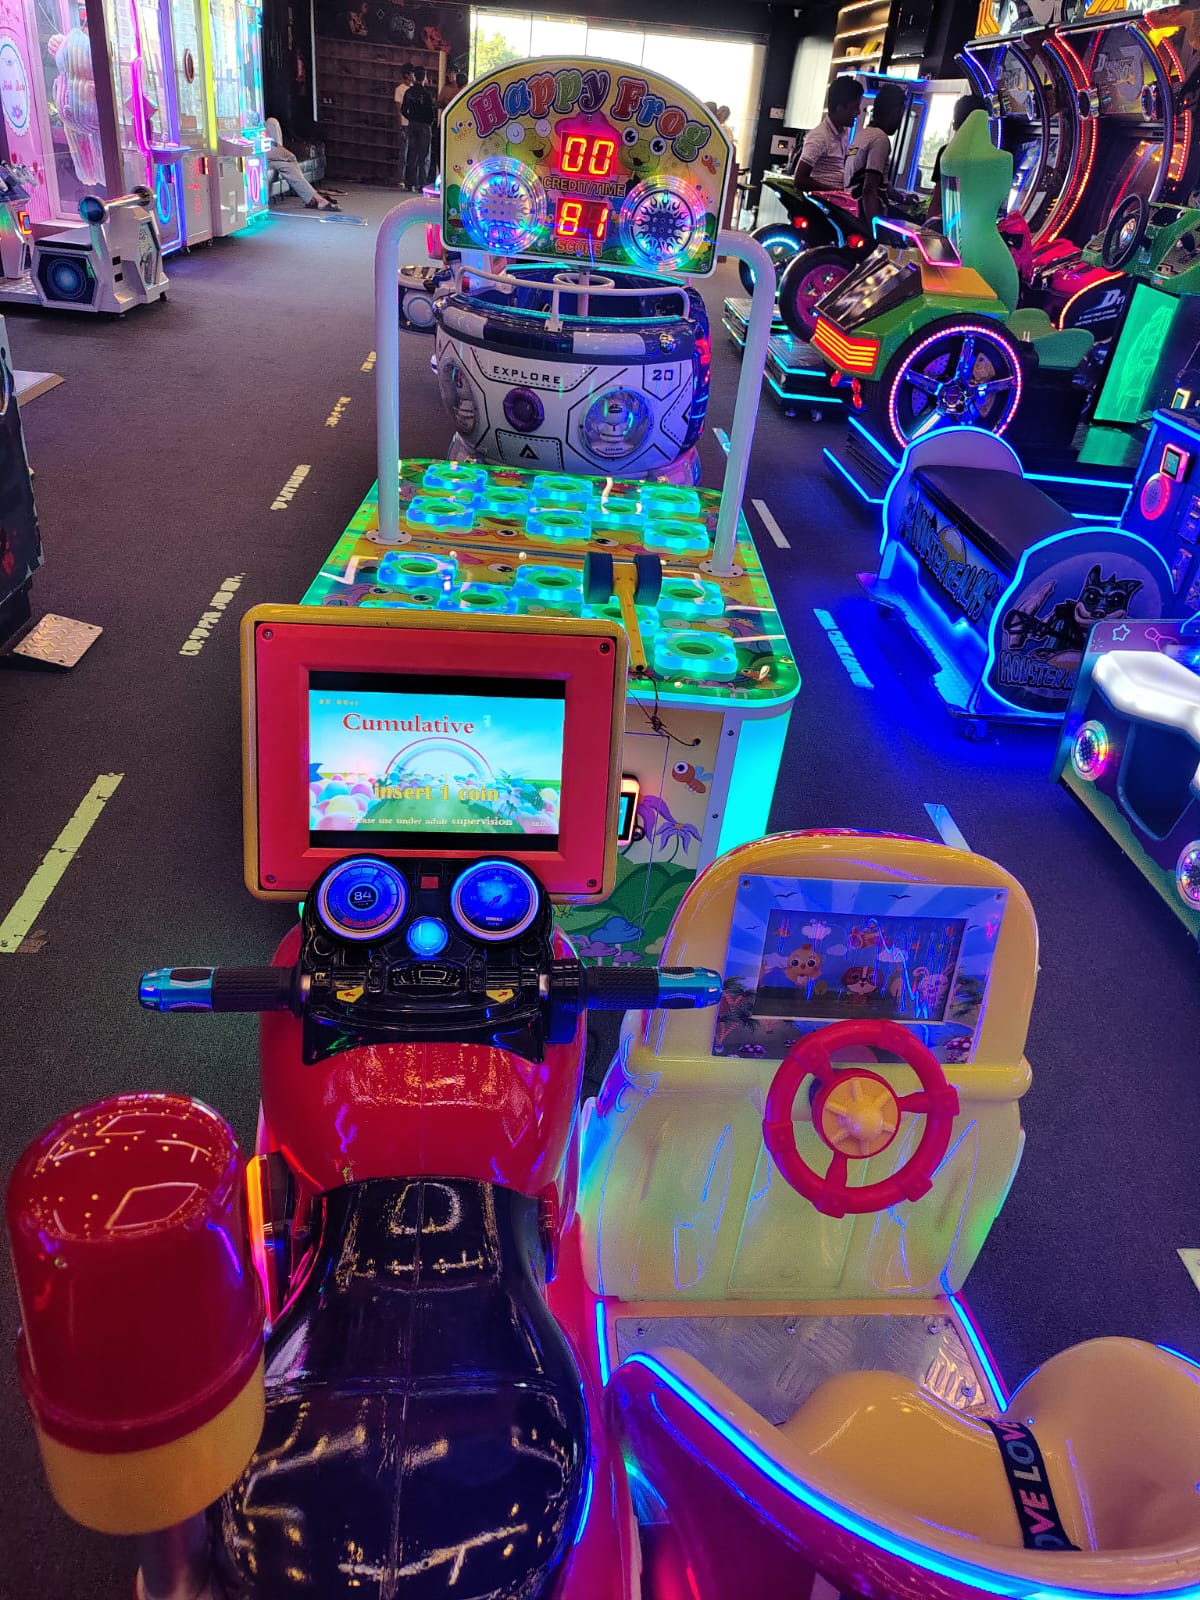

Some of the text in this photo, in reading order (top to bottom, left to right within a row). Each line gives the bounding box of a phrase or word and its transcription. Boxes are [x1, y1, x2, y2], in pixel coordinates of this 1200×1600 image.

[468, 70, 710, 161] Happy Frog
[562, 137, 614, 174] 00
[544, 176, 625, 196] CREDIT/TIME
[558, 202, 608, 237] 81
[557, 240, 602, 257] SCORE
[494, 365, 561, 384] EXPLORE
[652, 369, 674, 381] 20
[999, 650, 1066, 689] MONSTER
[342, 713, 475, 734] Cumulative
[375, 783, 499, 801] insert 1 coin
[396, 817, 422, 825] under
[425, 817, 448, 825] adult
[452, 817, 513, 827] supervision
[354, 890, 372, 900] 84
[1019, 1489, 1066, 1548] OVE
